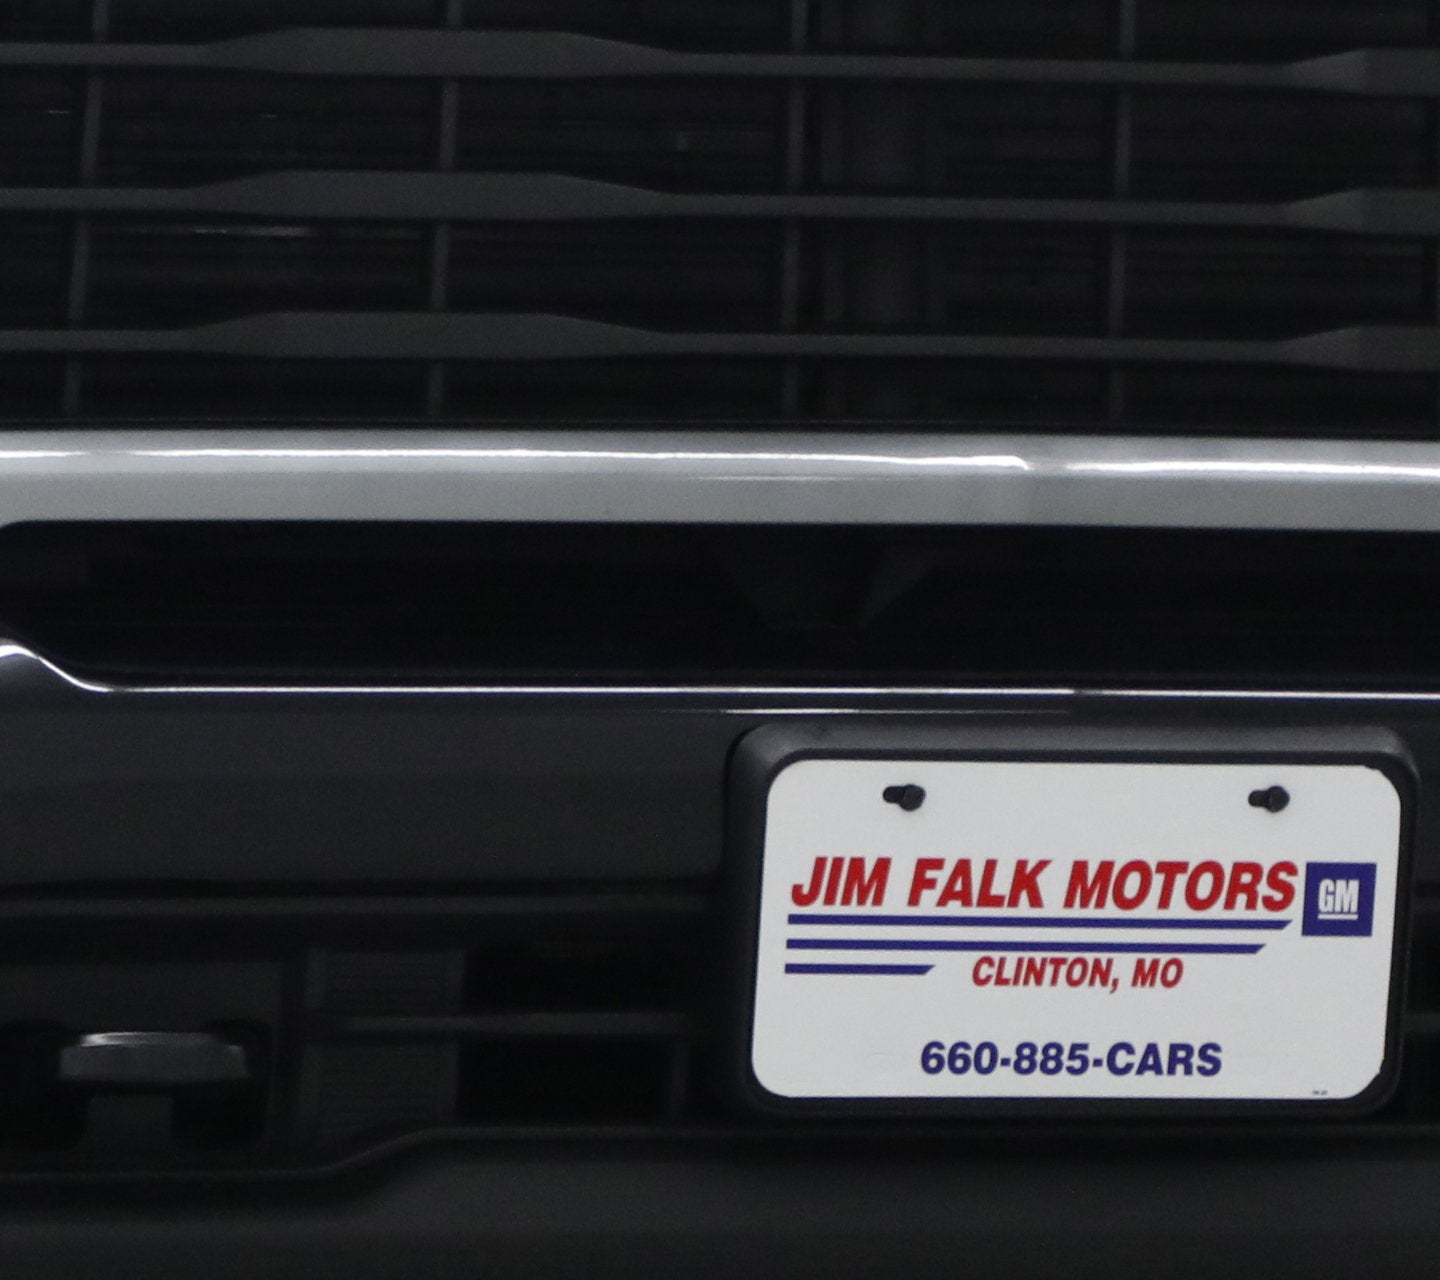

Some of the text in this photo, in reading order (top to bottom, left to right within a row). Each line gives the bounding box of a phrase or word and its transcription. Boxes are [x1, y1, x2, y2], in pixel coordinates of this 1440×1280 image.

[790, 855, 1300, 914] JIM FALK MOTORS
[1317, 878, 1360, 915] GM
[971, 954, 1185, 995] CLINTON, MO
[919, 1039, 1223, 1078] 660-885-CARS
